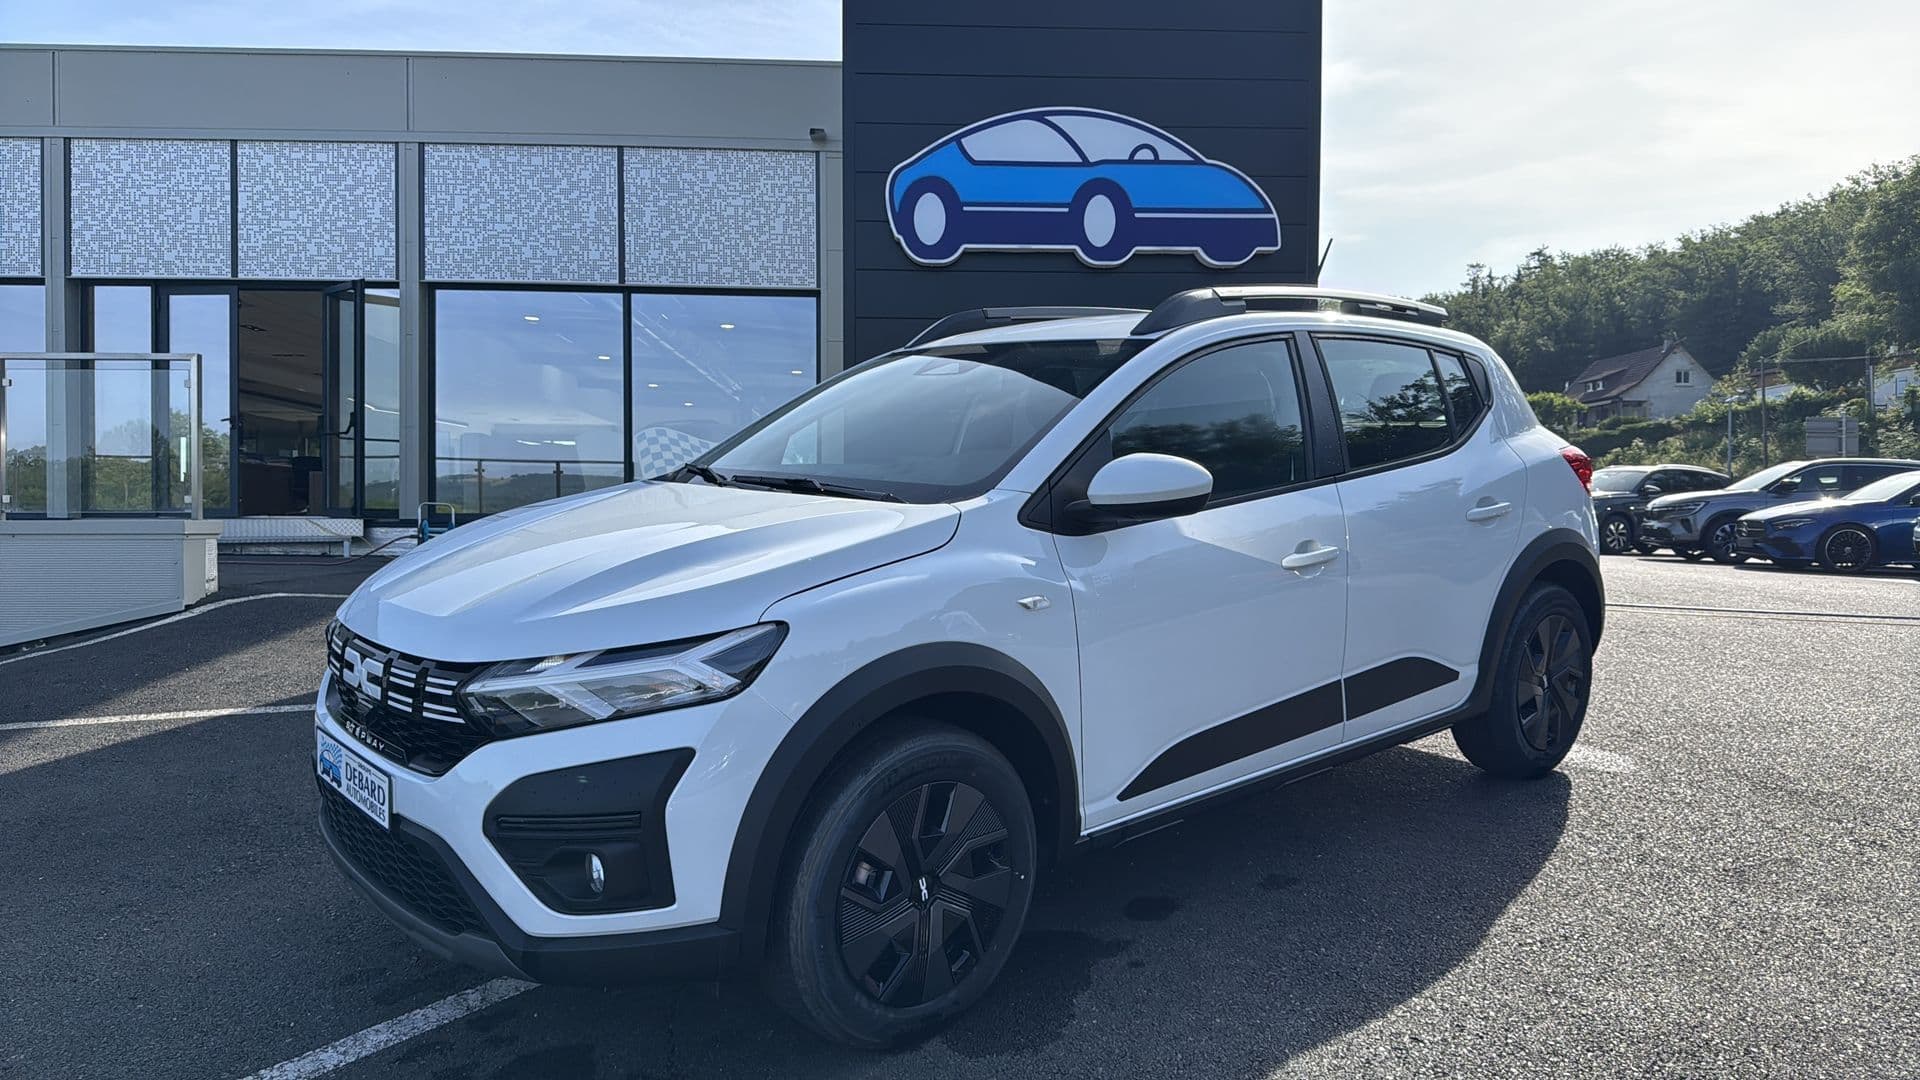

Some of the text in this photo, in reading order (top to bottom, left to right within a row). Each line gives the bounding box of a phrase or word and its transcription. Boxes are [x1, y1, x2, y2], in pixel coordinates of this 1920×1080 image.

[345, 720, 385, 751] STEPWAY
[345, 762, 386, 806] DEBARD
[345, 782, 386, 822] AUTOMOBILES
